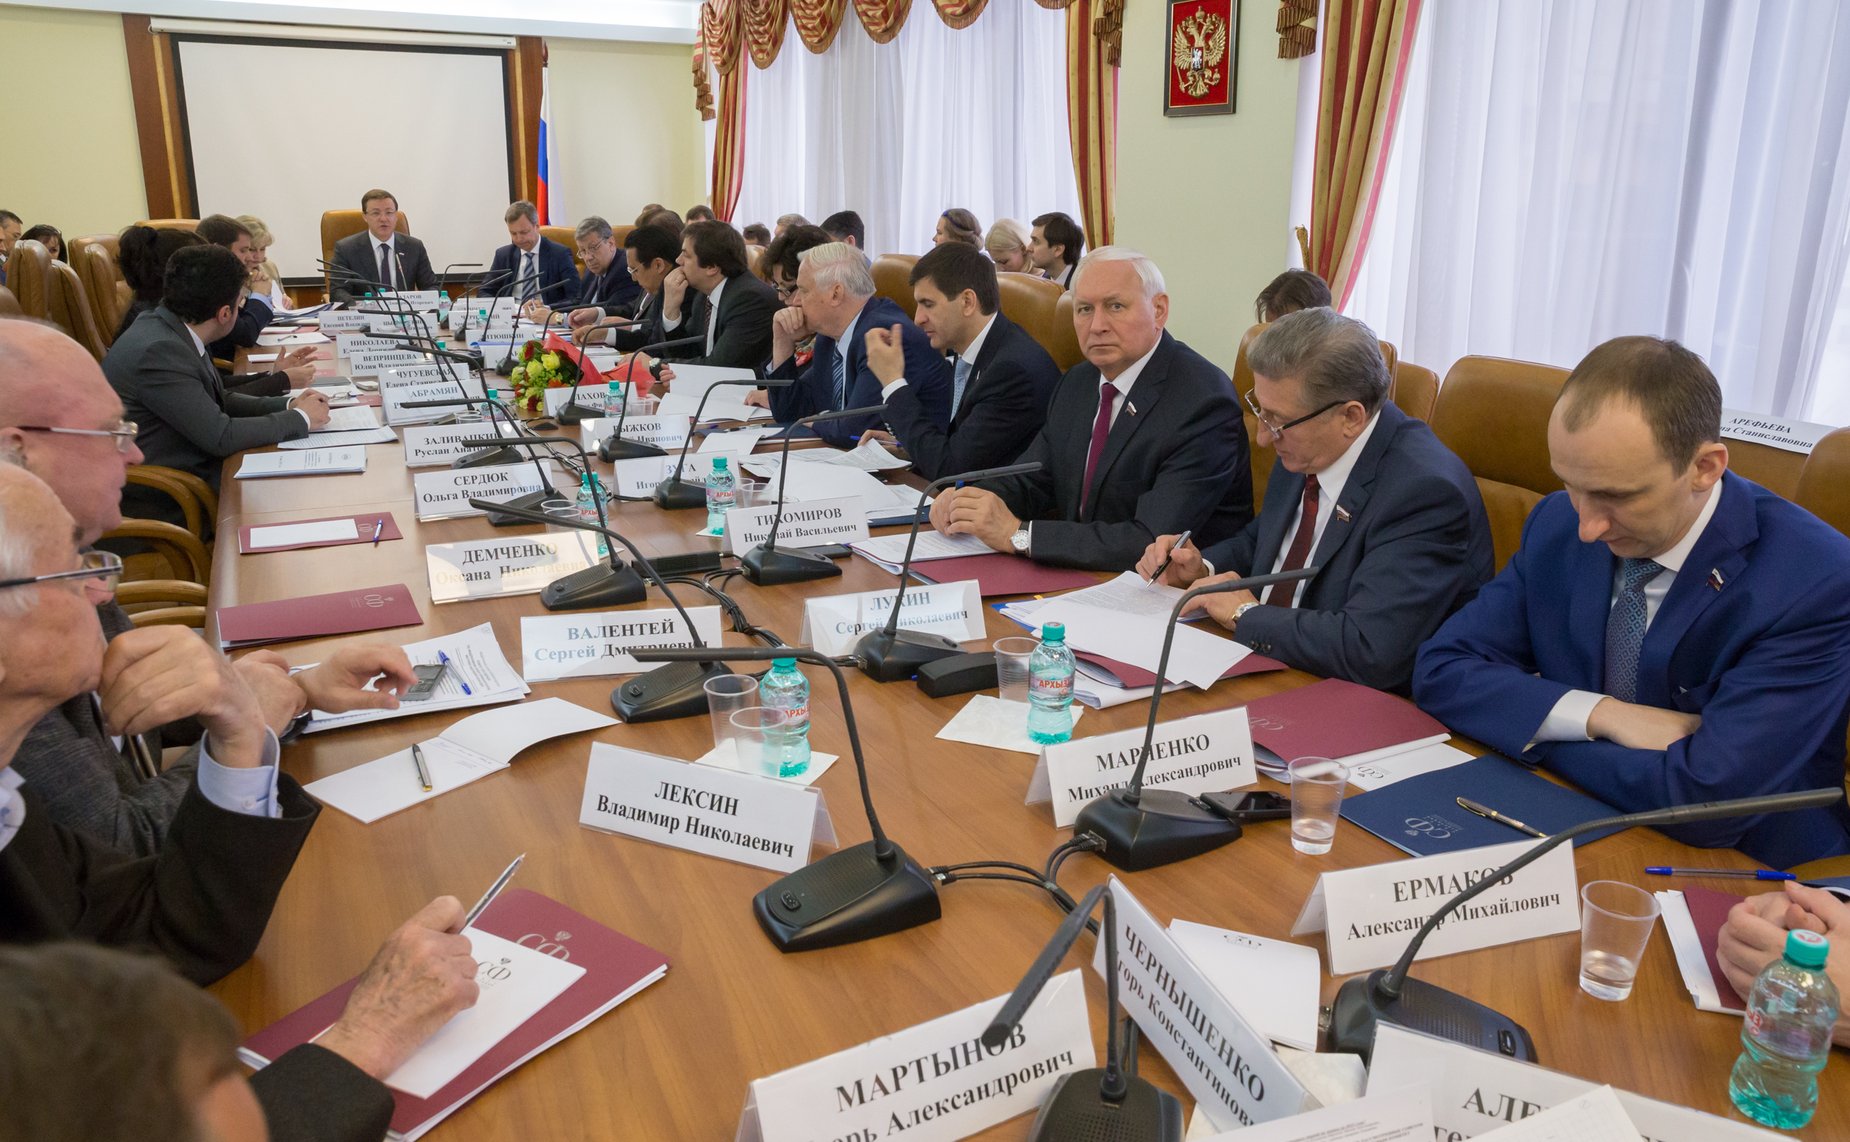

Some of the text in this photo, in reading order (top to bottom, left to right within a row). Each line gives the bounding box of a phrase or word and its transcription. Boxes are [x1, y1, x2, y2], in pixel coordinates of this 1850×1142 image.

[410, 386, 458, 398] АБРАМЯН
[1729, 418, 1792, 434] АРЕФЬЕВА
[1733, 427, 1813, 449] Станиславовна
[414, 447, 450, 458] Руслан
[453, 472, 509, 486] СЕРДЮК
[636, 480, 660, 491] Игор
[423, 491, 459, 503] Ольга
[744, 524, 858, 543] Никлай Васильевич
[462, 543, 559, 565] ДЕМЧЕНКО
[567, 618, 676, 641] ВАЛЕНТЕЙ
[898, 610, 969, 627] иколаевич
[534, 645, 596, 663] Сергей
[1139, 756, 1242, 788] лександрович
[654, 780, 740, 817] ЛЕКСИН
[596, 794, 795, 859] Владимир Николаевич
[1347, 892, 1561, 941] Алексанр Михайлович
[1118, 960, 1145, 1000] горь
[1125, 925, 1265, 1102] ЧЕРНЫШЕНКО
[886, 1050, 1074, 1137] Александрович
